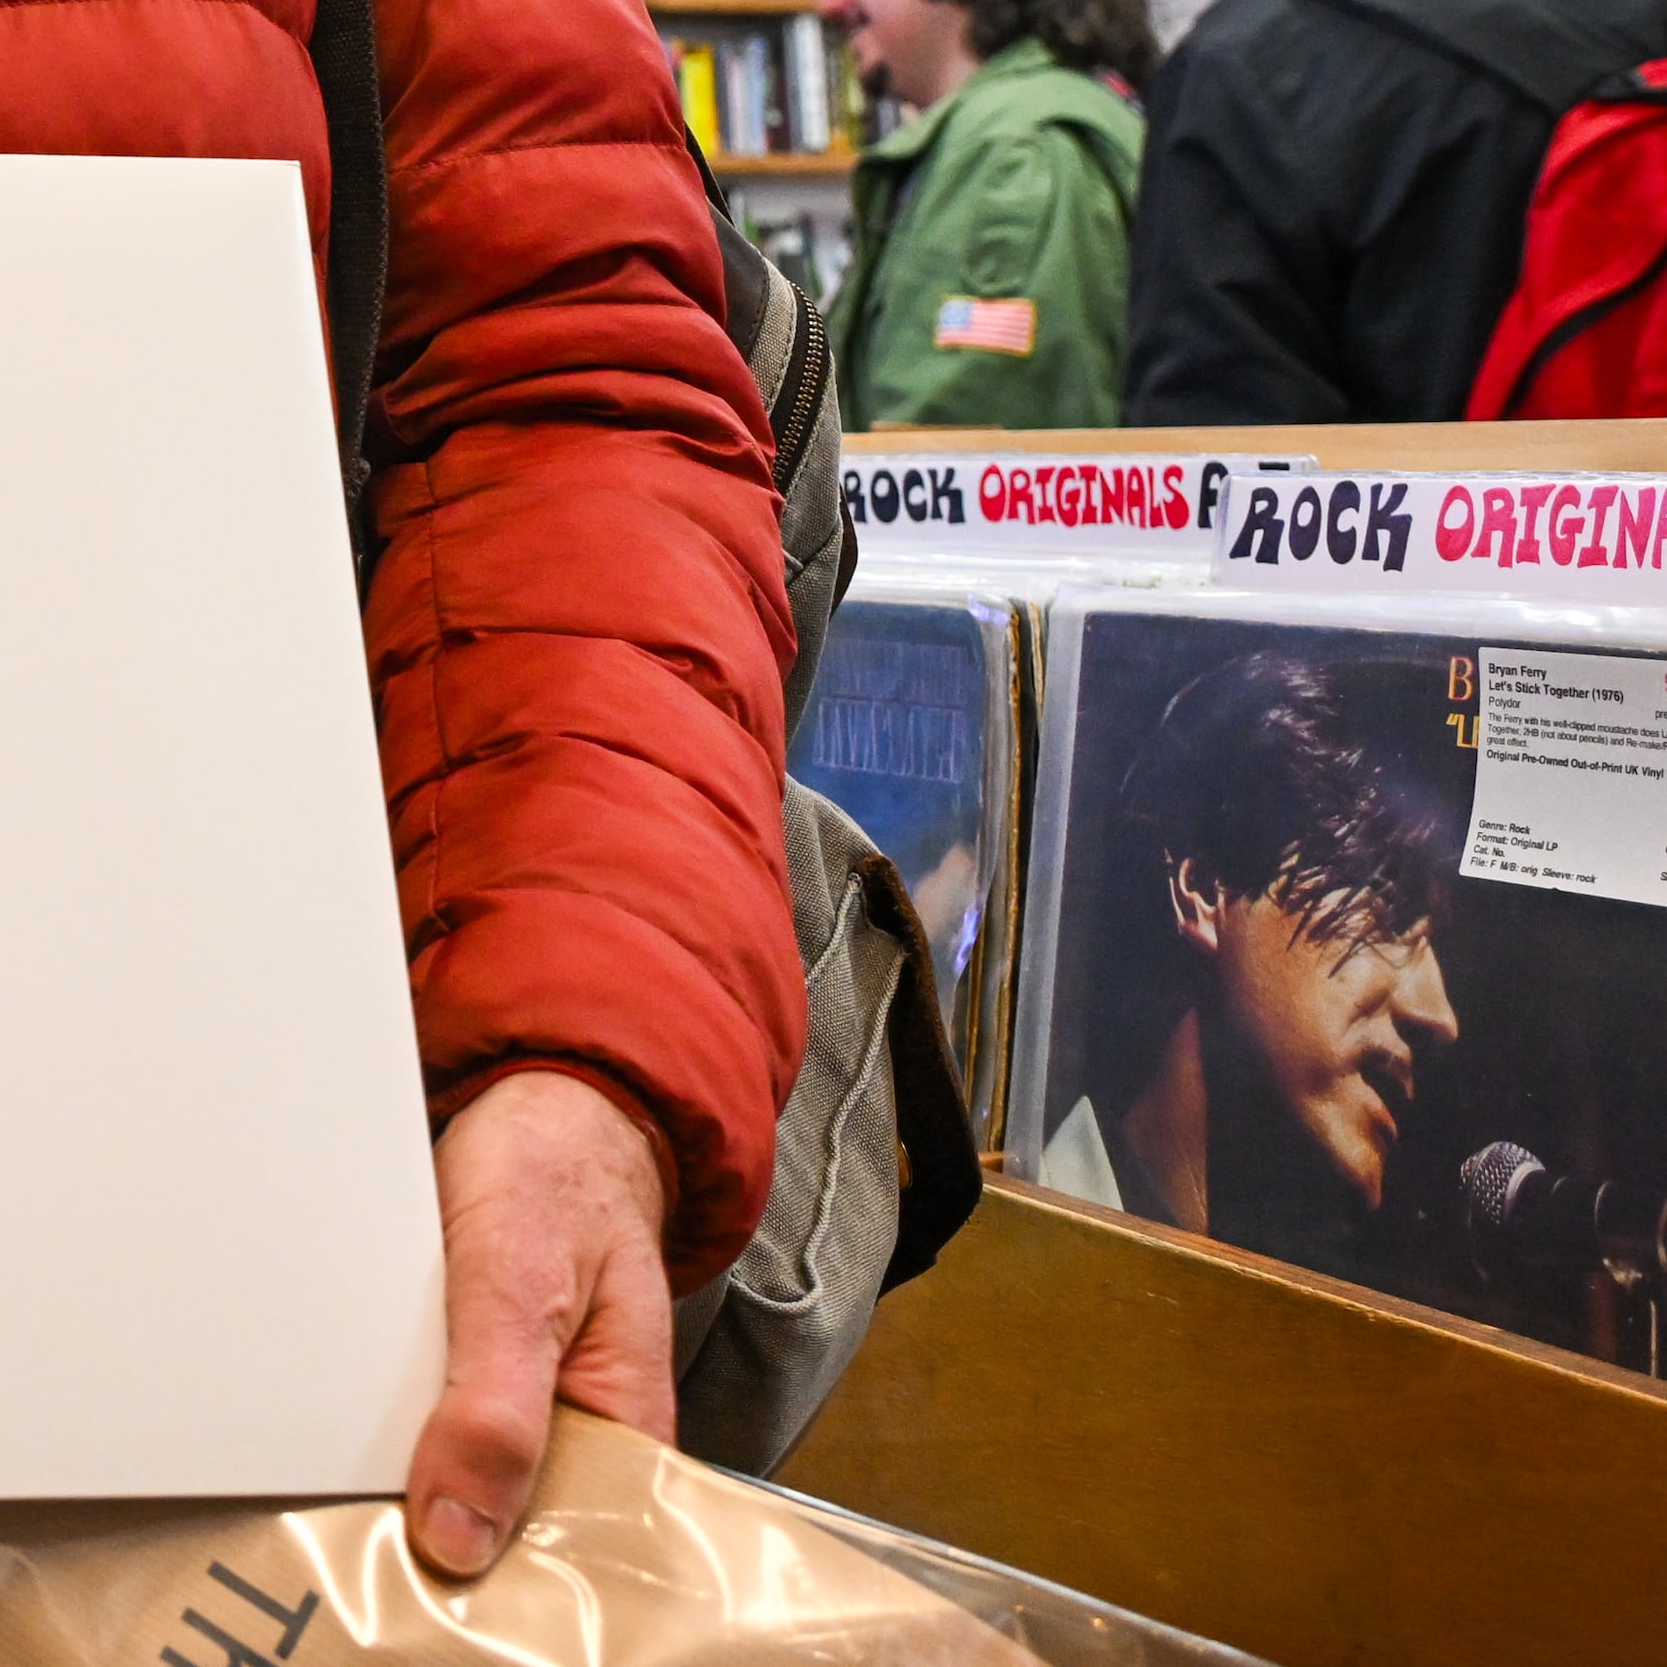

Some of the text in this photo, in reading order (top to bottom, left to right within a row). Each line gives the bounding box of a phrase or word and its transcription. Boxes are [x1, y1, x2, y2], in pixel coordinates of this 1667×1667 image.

[844, 466, 966, 524] ROCK
[979, 462, 1190, 530] ORIGINALS
[1229, 479, 1412, 572] ROCK
[1488, 663, 1547, 681] Bryan Ferry
[1488, 680, 1624, 704] Let's Stick Together (1976)
[1488, 696, 1521, 709] Polydor
[1488, 713, 1502, 722] The
[1504, 714, 1522, 725] Ferry
[1524, 716, 1538, 725] with
[1540, 717, 1551, 727] his
[1553, 719, 1596, 732] well-clipped
[1597, 723, 1638, 736] moustache
[1640, 728, 1660, 738] does
[1487, 736, 1505, 748] great
[1541, 729, 1555, 739] (not
[1557, 731, 1577, 741] about
[1578, 733, 1608, 745] pencils)
[1610, 736, 1624, 746] and
[1486, 749, 1664, 780] Original Pre-Owned Out-of-Print UK Vinyl
[1479, 819, 1530, 835] Genre: Rock
[1473, 845, 1505, 857] Cat. No.
[1476, 832, 1558, 851] Format: Original LP
[1470, 857, 1489, 868] File:
[1521, 866, 1538, 877] orig
[1542, 868, 1574, 881] Sleeve:
[1576, 874, 1596, 884] rock
